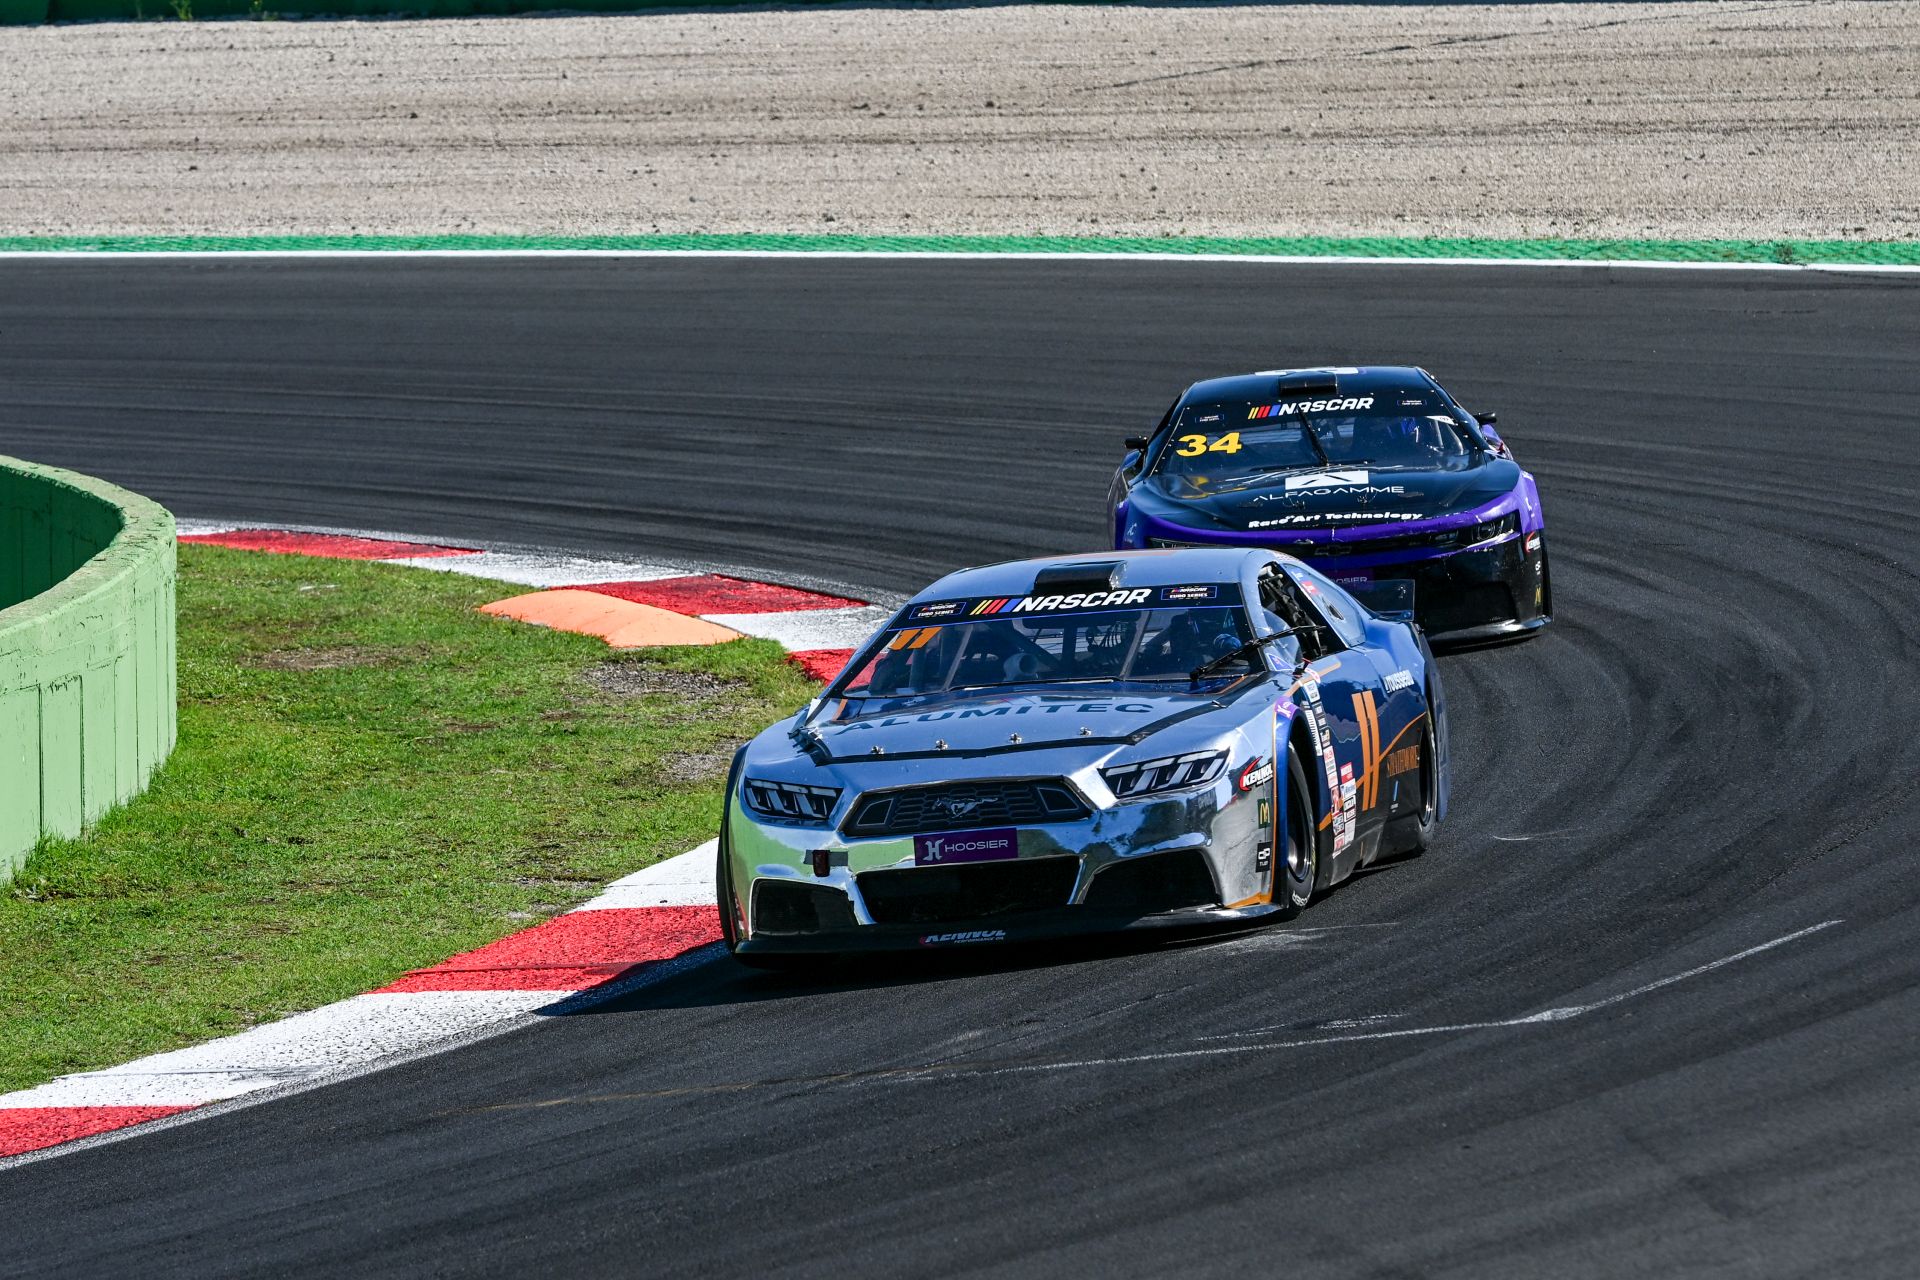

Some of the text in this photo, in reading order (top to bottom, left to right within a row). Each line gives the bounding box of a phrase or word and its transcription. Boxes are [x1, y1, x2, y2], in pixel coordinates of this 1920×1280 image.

[1278, 397, 1375, 416] NASCAR
[1175, 432, 1242, 458] 34
[1012, 588, 1152, 612] NASCAR
[834, 702, 1155, 736] ALUMITEC
[944, 839, 1009, 853] HOOSIER
